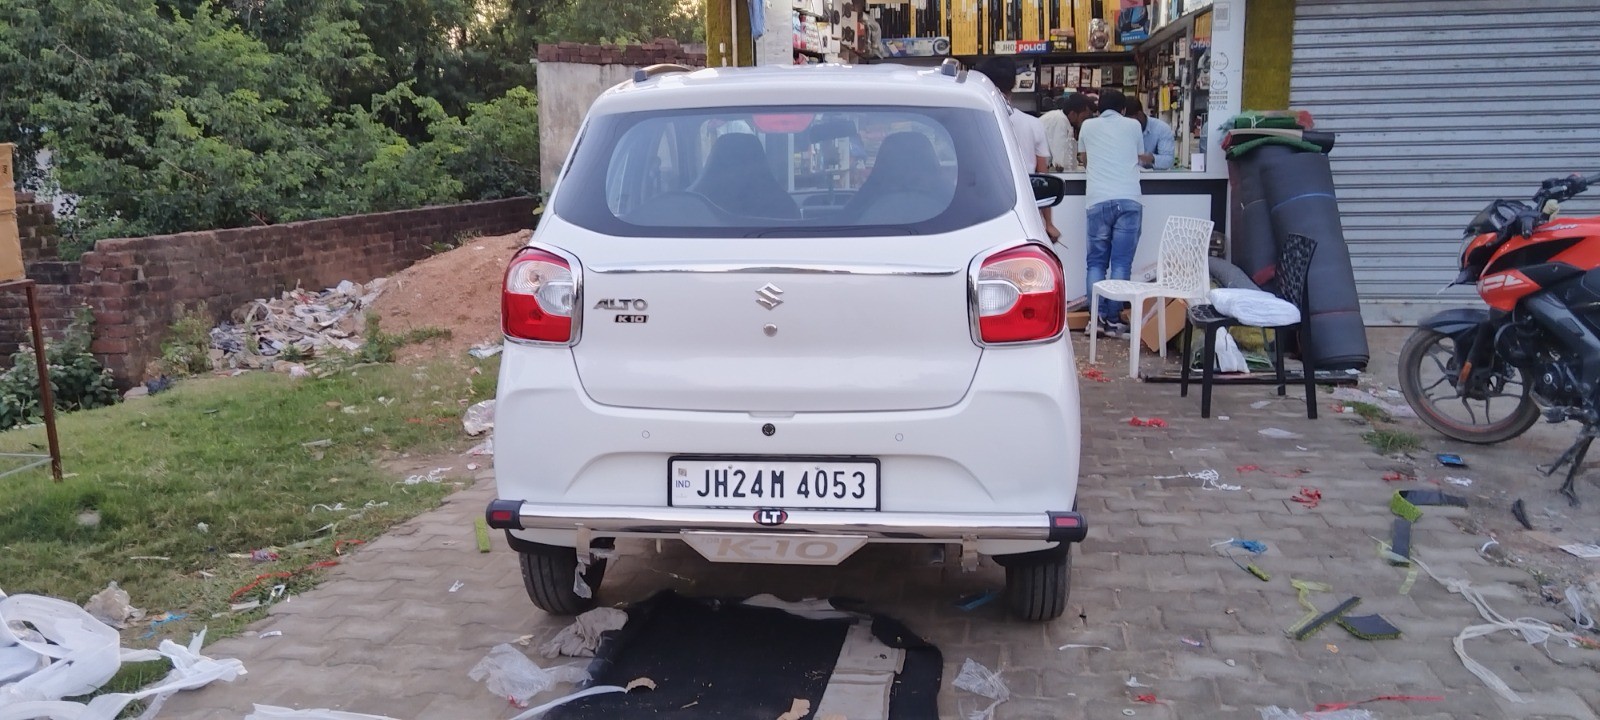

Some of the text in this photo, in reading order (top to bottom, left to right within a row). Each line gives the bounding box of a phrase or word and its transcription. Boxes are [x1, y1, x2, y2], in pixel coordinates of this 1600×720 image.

[1018, 43, 1047, 52] POLICE
[593, 298, 648, 311] ALTO
[617, 315, 645, 323] K10
[675, 480, 691, 488] IND
[696, 469, 866, 500] JH24M 4053
[761, 510, 781, 524] LT
[717, 538, 838, 560] K-10
